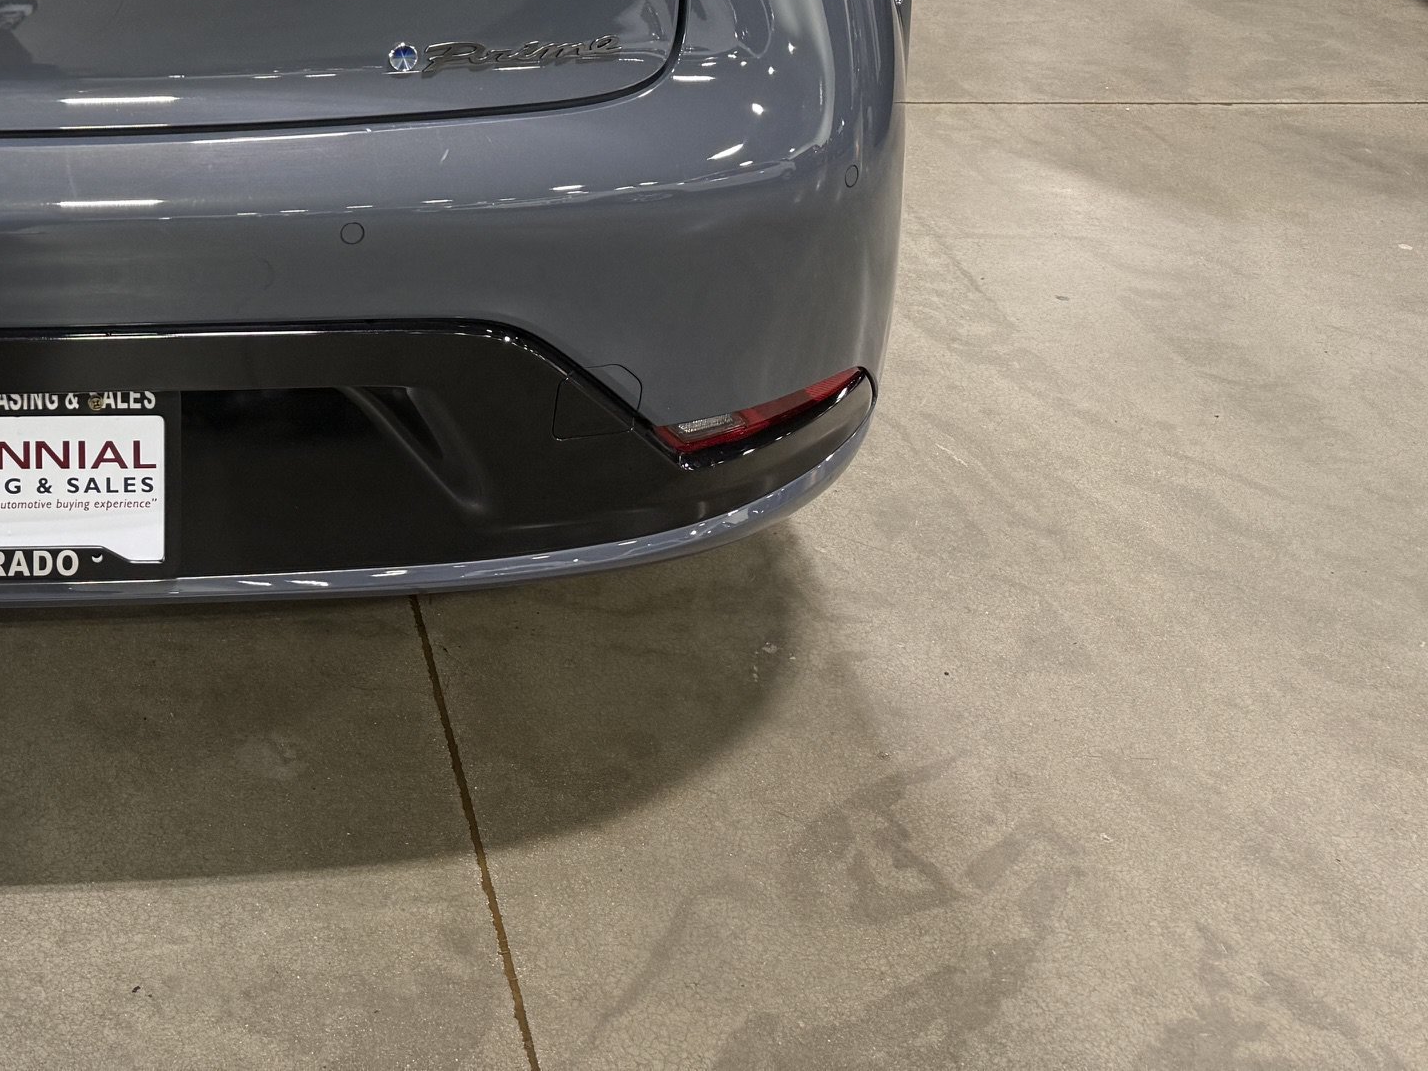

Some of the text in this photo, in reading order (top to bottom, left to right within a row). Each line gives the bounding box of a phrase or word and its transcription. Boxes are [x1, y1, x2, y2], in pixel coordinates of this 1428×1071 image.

[422, 34, 622, 73] Prime
[65, 393, 79, 410] &
[88, 391, 156, 410] ALES
[37, 478, 52, 495] &
[67, 477, 154, 494] SALES
[56, 499, 90, 511] buying
